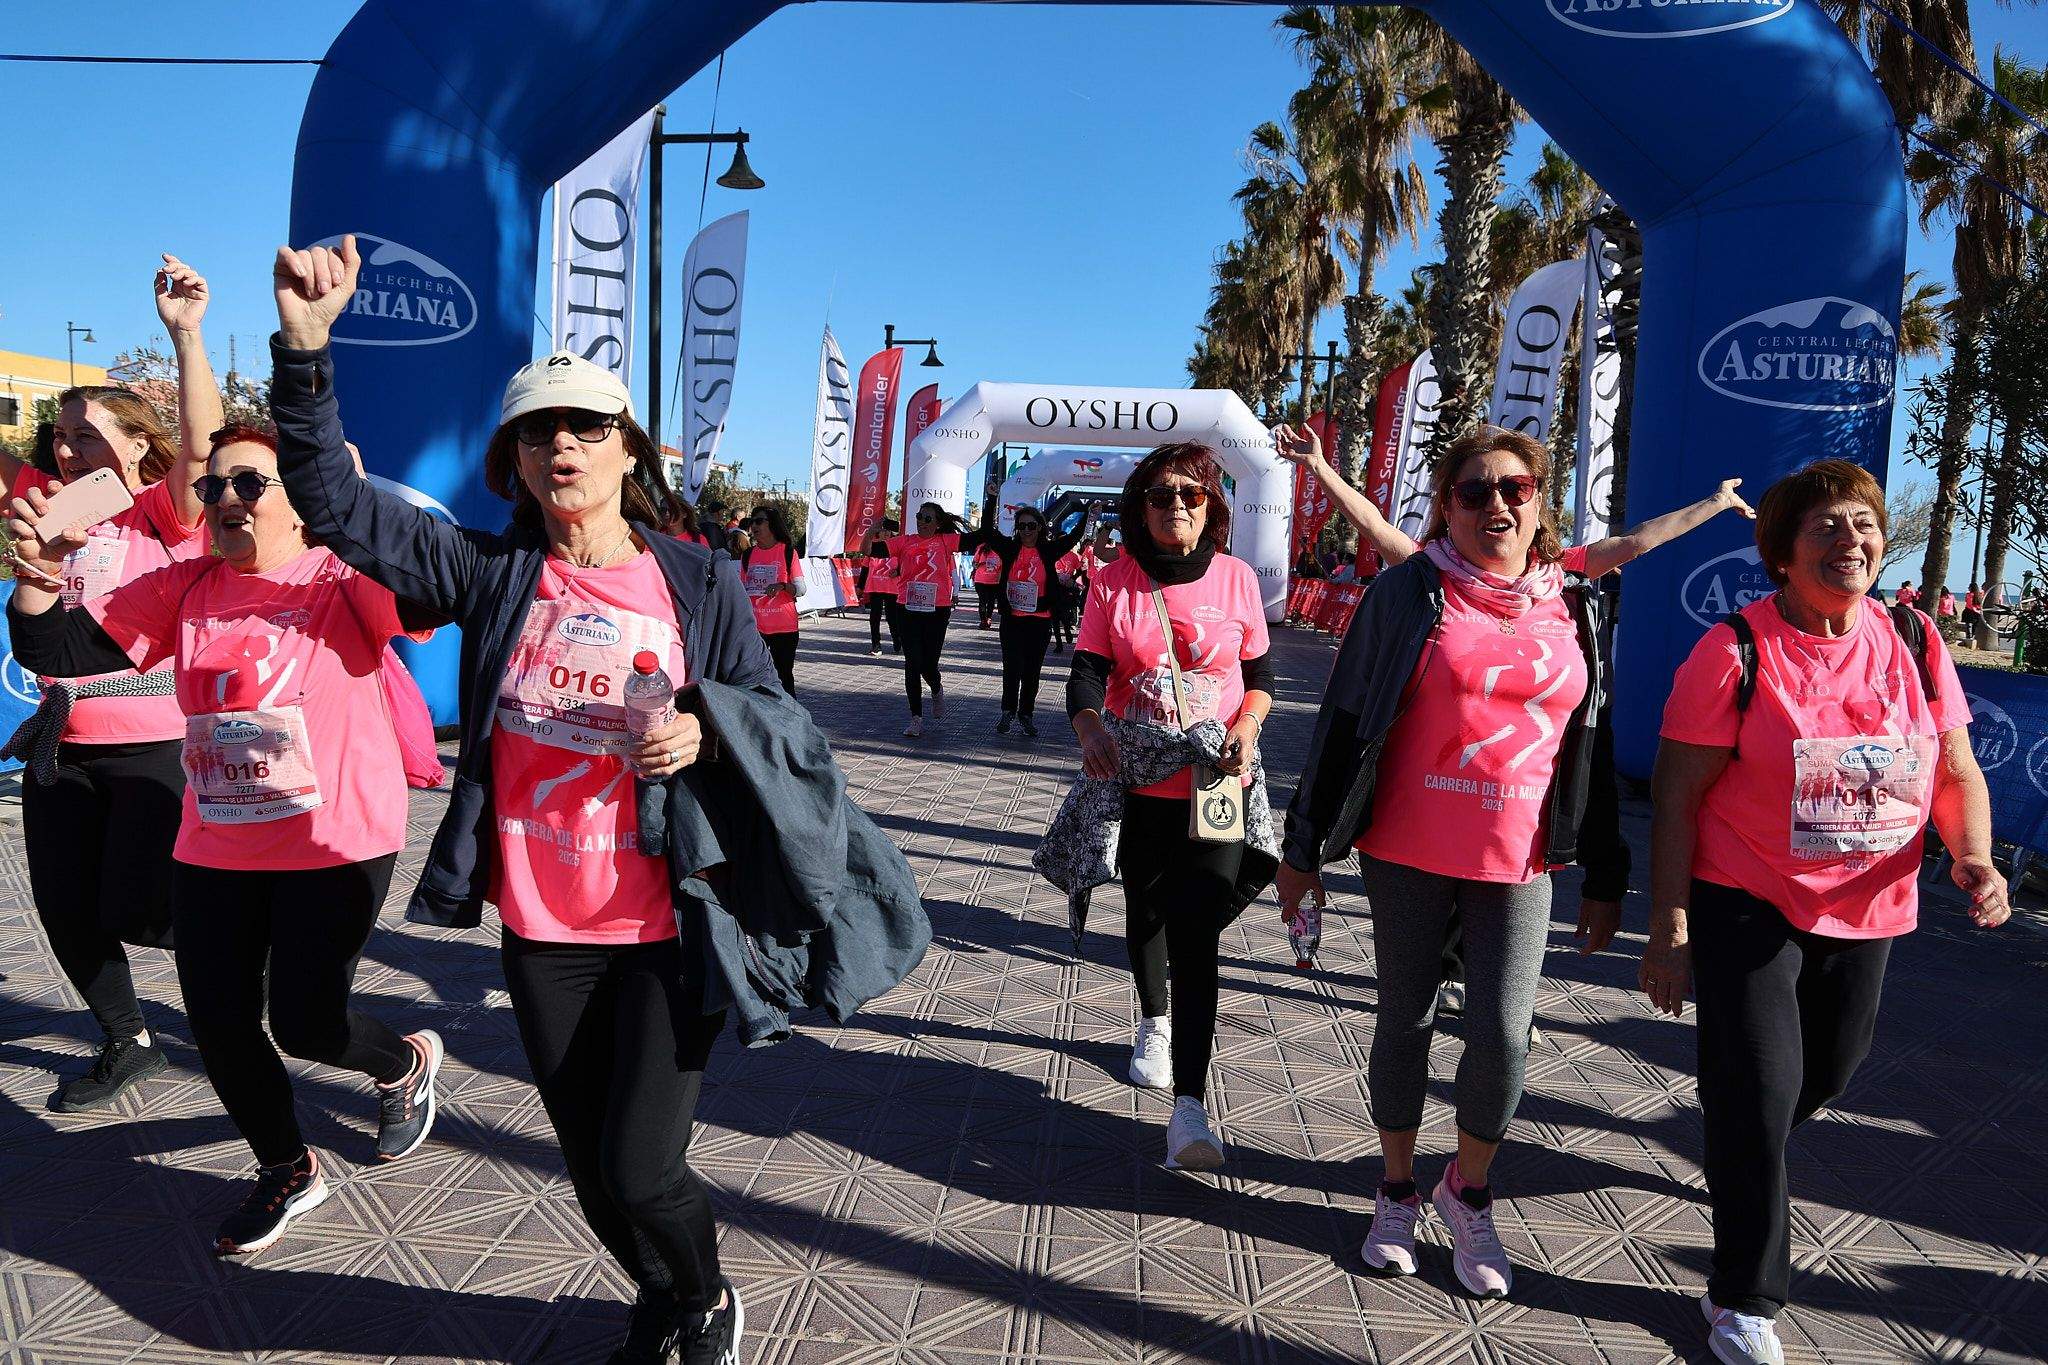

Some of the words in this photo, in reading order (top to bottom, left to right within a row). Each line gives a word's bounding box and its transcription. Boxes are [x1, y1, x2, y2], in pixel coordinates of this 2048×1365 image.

[376, 273, 455, 295] LECHERA
[564, 188, 630, 371] SHO
[343, 288, 461, 329] RIANA
[1757, 336, 1838, 347] CENTRAL
[1845, 337, 1893, 352] LECHER
[1499, 304, 1561, 440] SHO
[866, 373, 889, 460] Santander
[1025, 397, 1179, 433] OYSHO
[815, 356, 852, 517] OYSHO
[934, 427, 980, 440] OYSHO
[1221, 438, 1268, 448] OYSHO
[911, 487, 953, 500] OYSHO
[856, 485, 877, 537] Sports
[1243, 503, 1287, 515] OYSHO
[1248, 566, 1283, 578] SHO
[64, 576, 85, 591] 16
[561, 621, 615, 642] ASTURIANA
[549, 665, 611, 697] 016
[558, 696, 586, 712] 7334
[543, 708, 554, 717] DE
[555, 711, 564, 720] LA
[566, 714, 591, 726] MUJER
[1153, 707, 1175, 724] 01
[216, 729, 260, 740] ASTURIANA
[512, 716, 553, 736] OYHO
[1843, 754, 1891, 765] ASTURIANA
[224, 760, 270, 781] 016
[234, 784, 256, 794] 7277
[1424, 774, 1478, 795] CARRERA
[1482, 782, 1498, 797] DE
[1500, 784, 1515, 798] LA
[244, 795, 265, 803] MUJER
[269, 789, 301, 800] VALENCIA
[1842, 787, 1890, 807] 016
[208, 808, 242, 818] OYSHO
[1481, 799, 1505, 812] 2025
[1852, 811, 1877, 821] 1073
[1851, 823, 1860, 831] LA
[556, 829, 573, 848] DE
[575, 834, 593, 852] LA
[597, 831, 637, 852] MUJE
[558, 850, 581, 867] 2025
[1845, 859, 1870, 871] 2025
